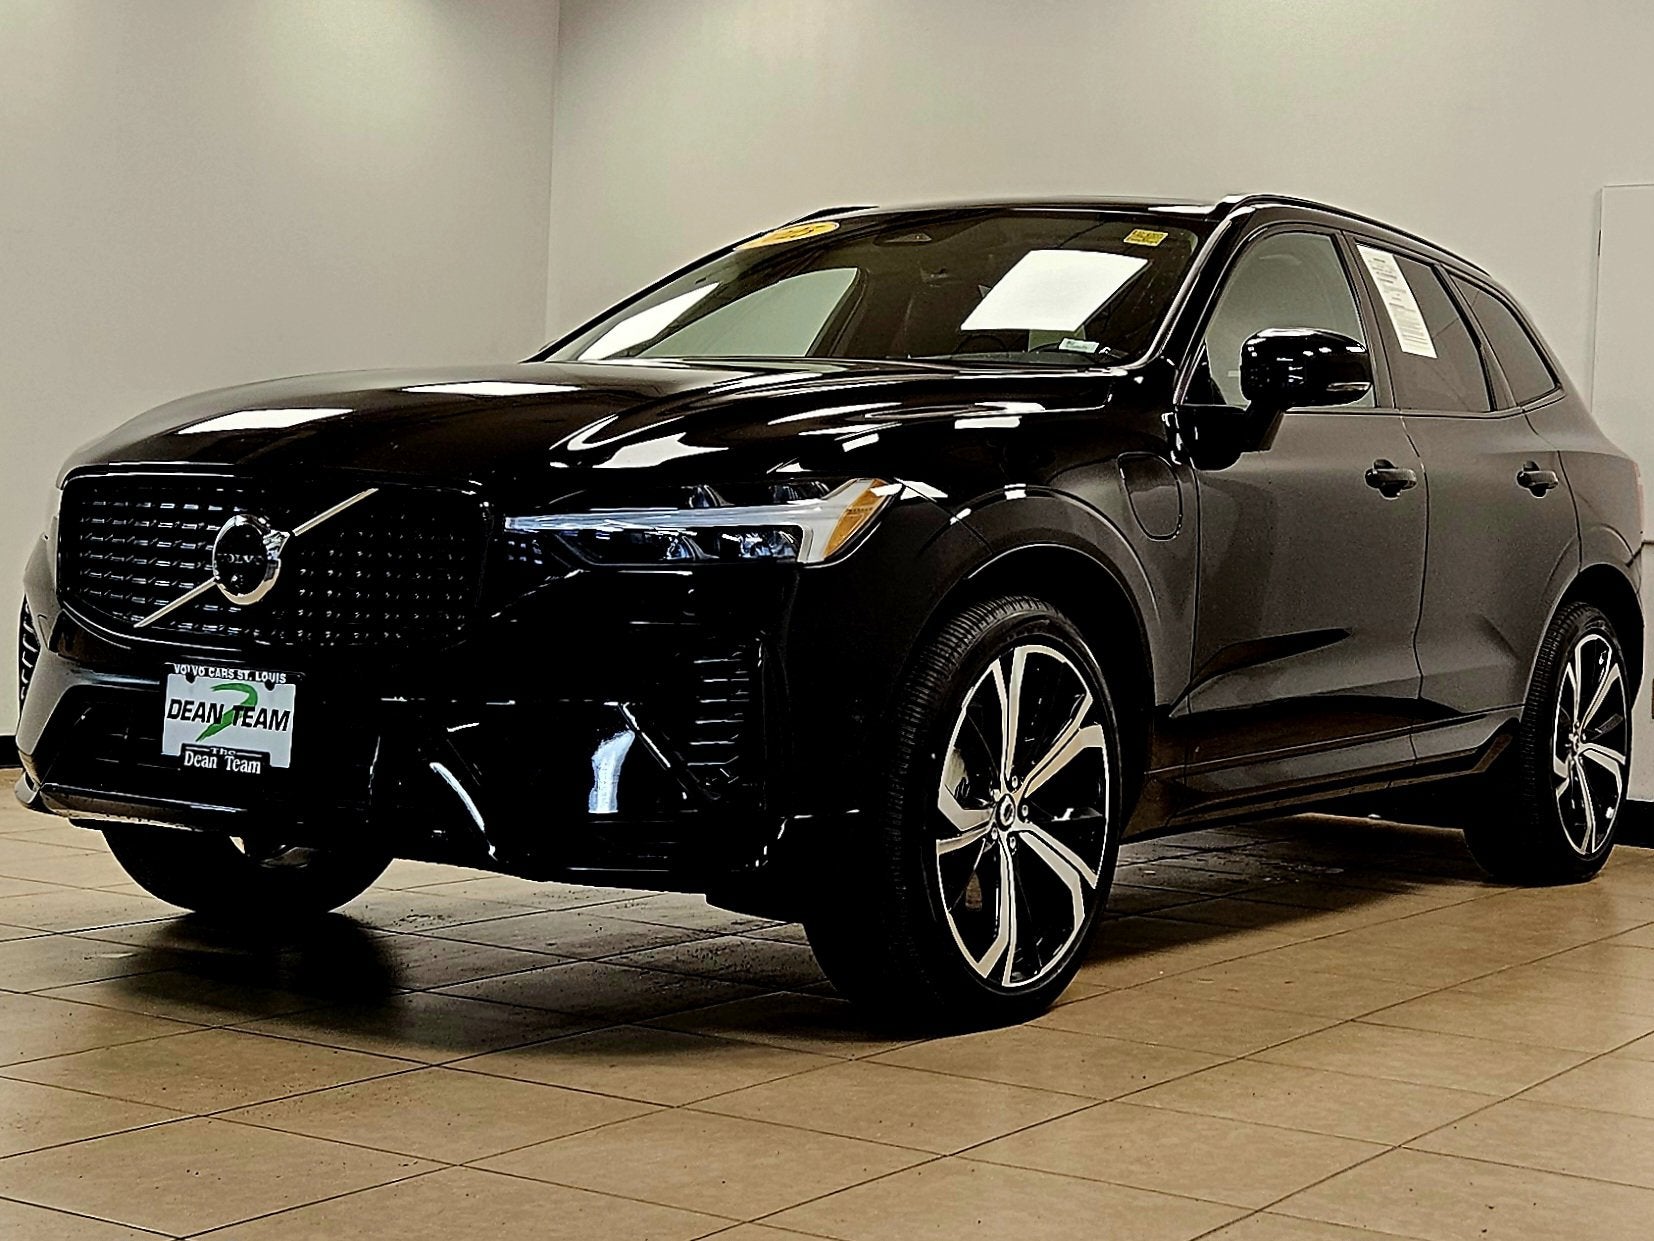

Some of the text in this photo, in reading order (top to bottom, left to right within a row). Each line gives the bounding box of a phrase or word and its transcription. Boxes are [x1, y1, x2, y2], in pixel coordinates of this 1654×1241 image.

[208, 667, 234, 679] CARS
[237, 670, 252, 681] ST.
[255, 671, 287, 684] LOUIS
[166, 698, 291, 732] DEAN TEAM
[184, 750, 262, 774] Dean Team
